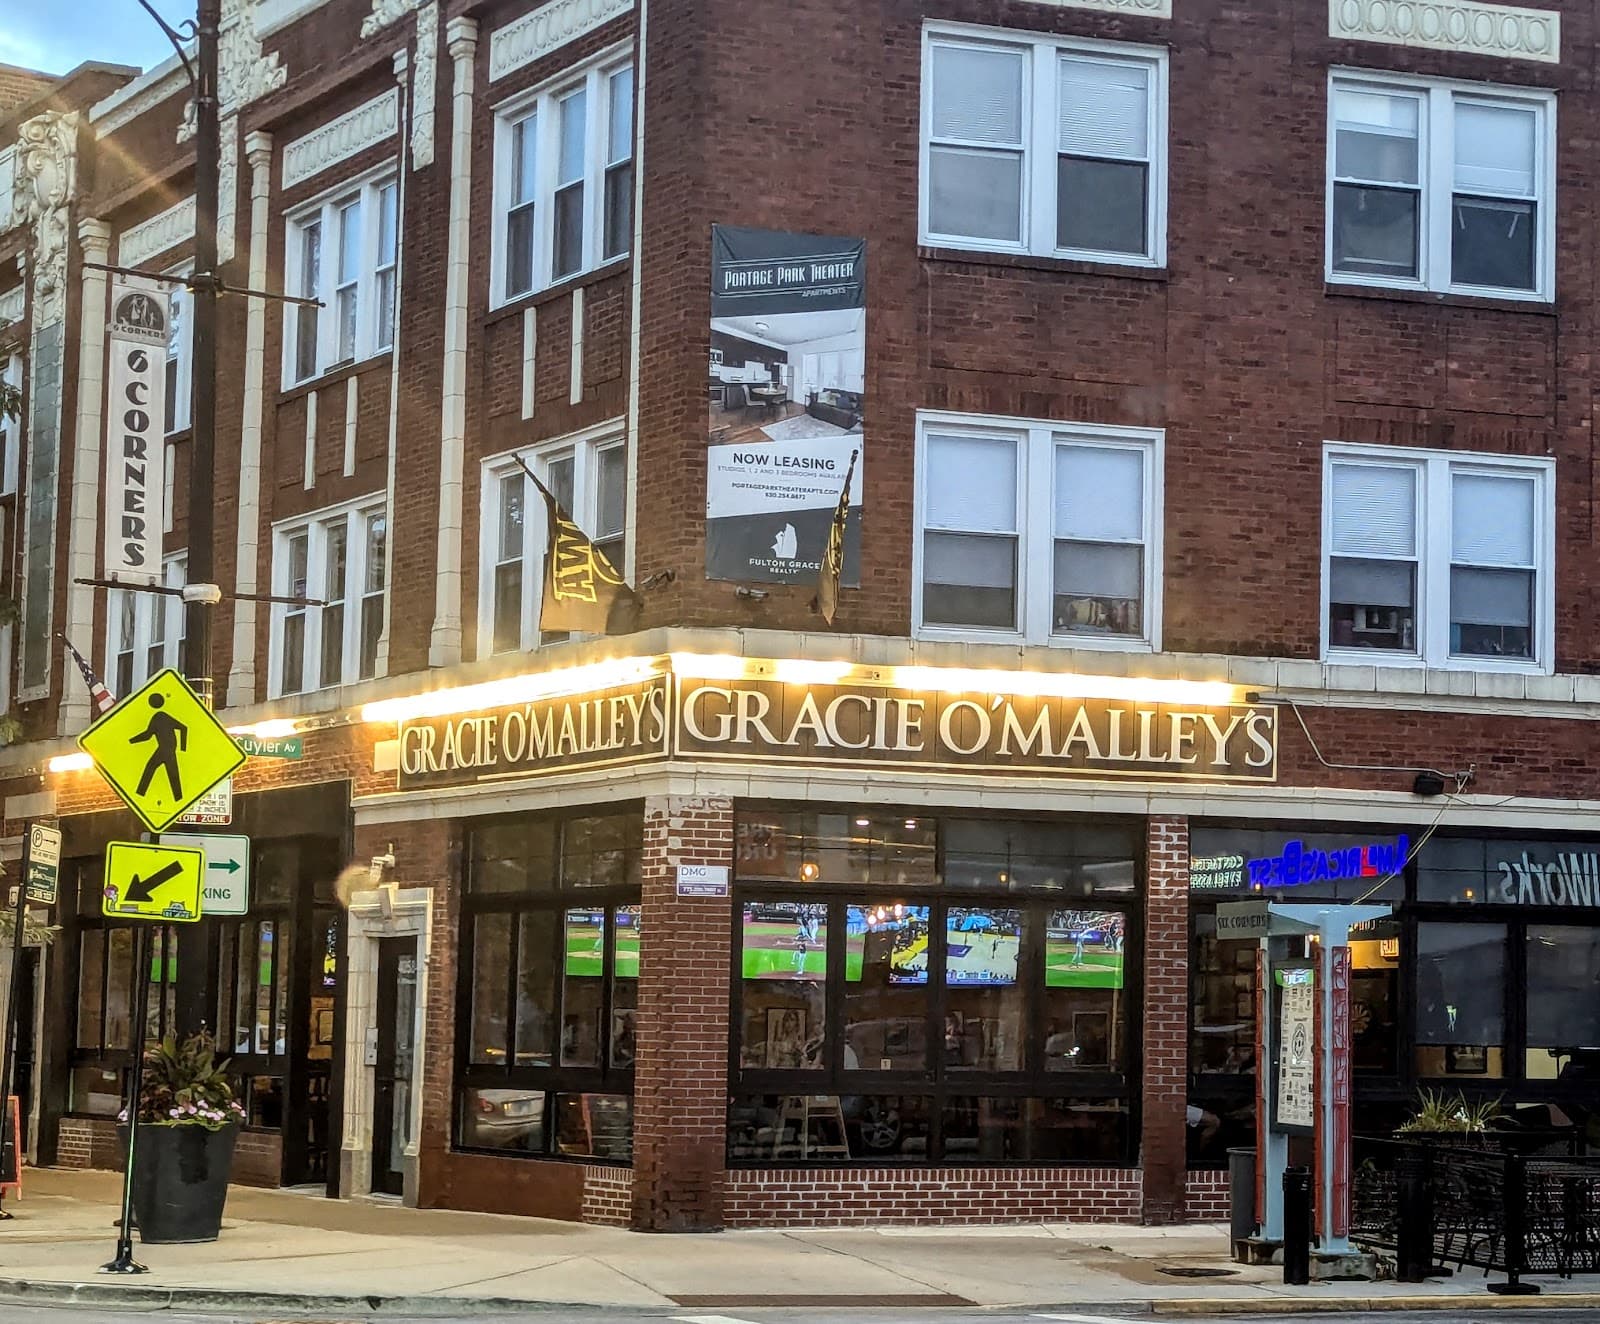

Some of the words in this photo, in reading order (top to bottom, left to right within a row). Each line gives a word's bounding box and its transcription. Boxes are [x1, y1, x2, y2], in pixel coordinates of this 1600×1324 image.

[724, 269, 774, 290] PORTAGE
[777, 265, 806, 286] PARK
[811, 262, 854, 283] THEATER
[801, 287, 848, 298] APARTMENTS
[127, 349, 149, 373] 6
[732, 452, 770, 466] NOW
[774, 455, 836, 471] LEASING
[122, 381, 150, 567] CORNERS
[750, 557, 786, 568] FULTON
[788, 560, 821, 570] GRACE
[401, 715, 498, 776] GRACIE
[502, 685, 665, 764] O'MALLEY'S
[682, 686, 925, 753] GRACIE
[939, 694, 1274, 769] O'MALLEY'S
[283, 744, 297, 753] Av
[201, 814, 226, 823] ZONE
[681, 867, 706, 877] DMG
[202, 888, 231, 899] KING
